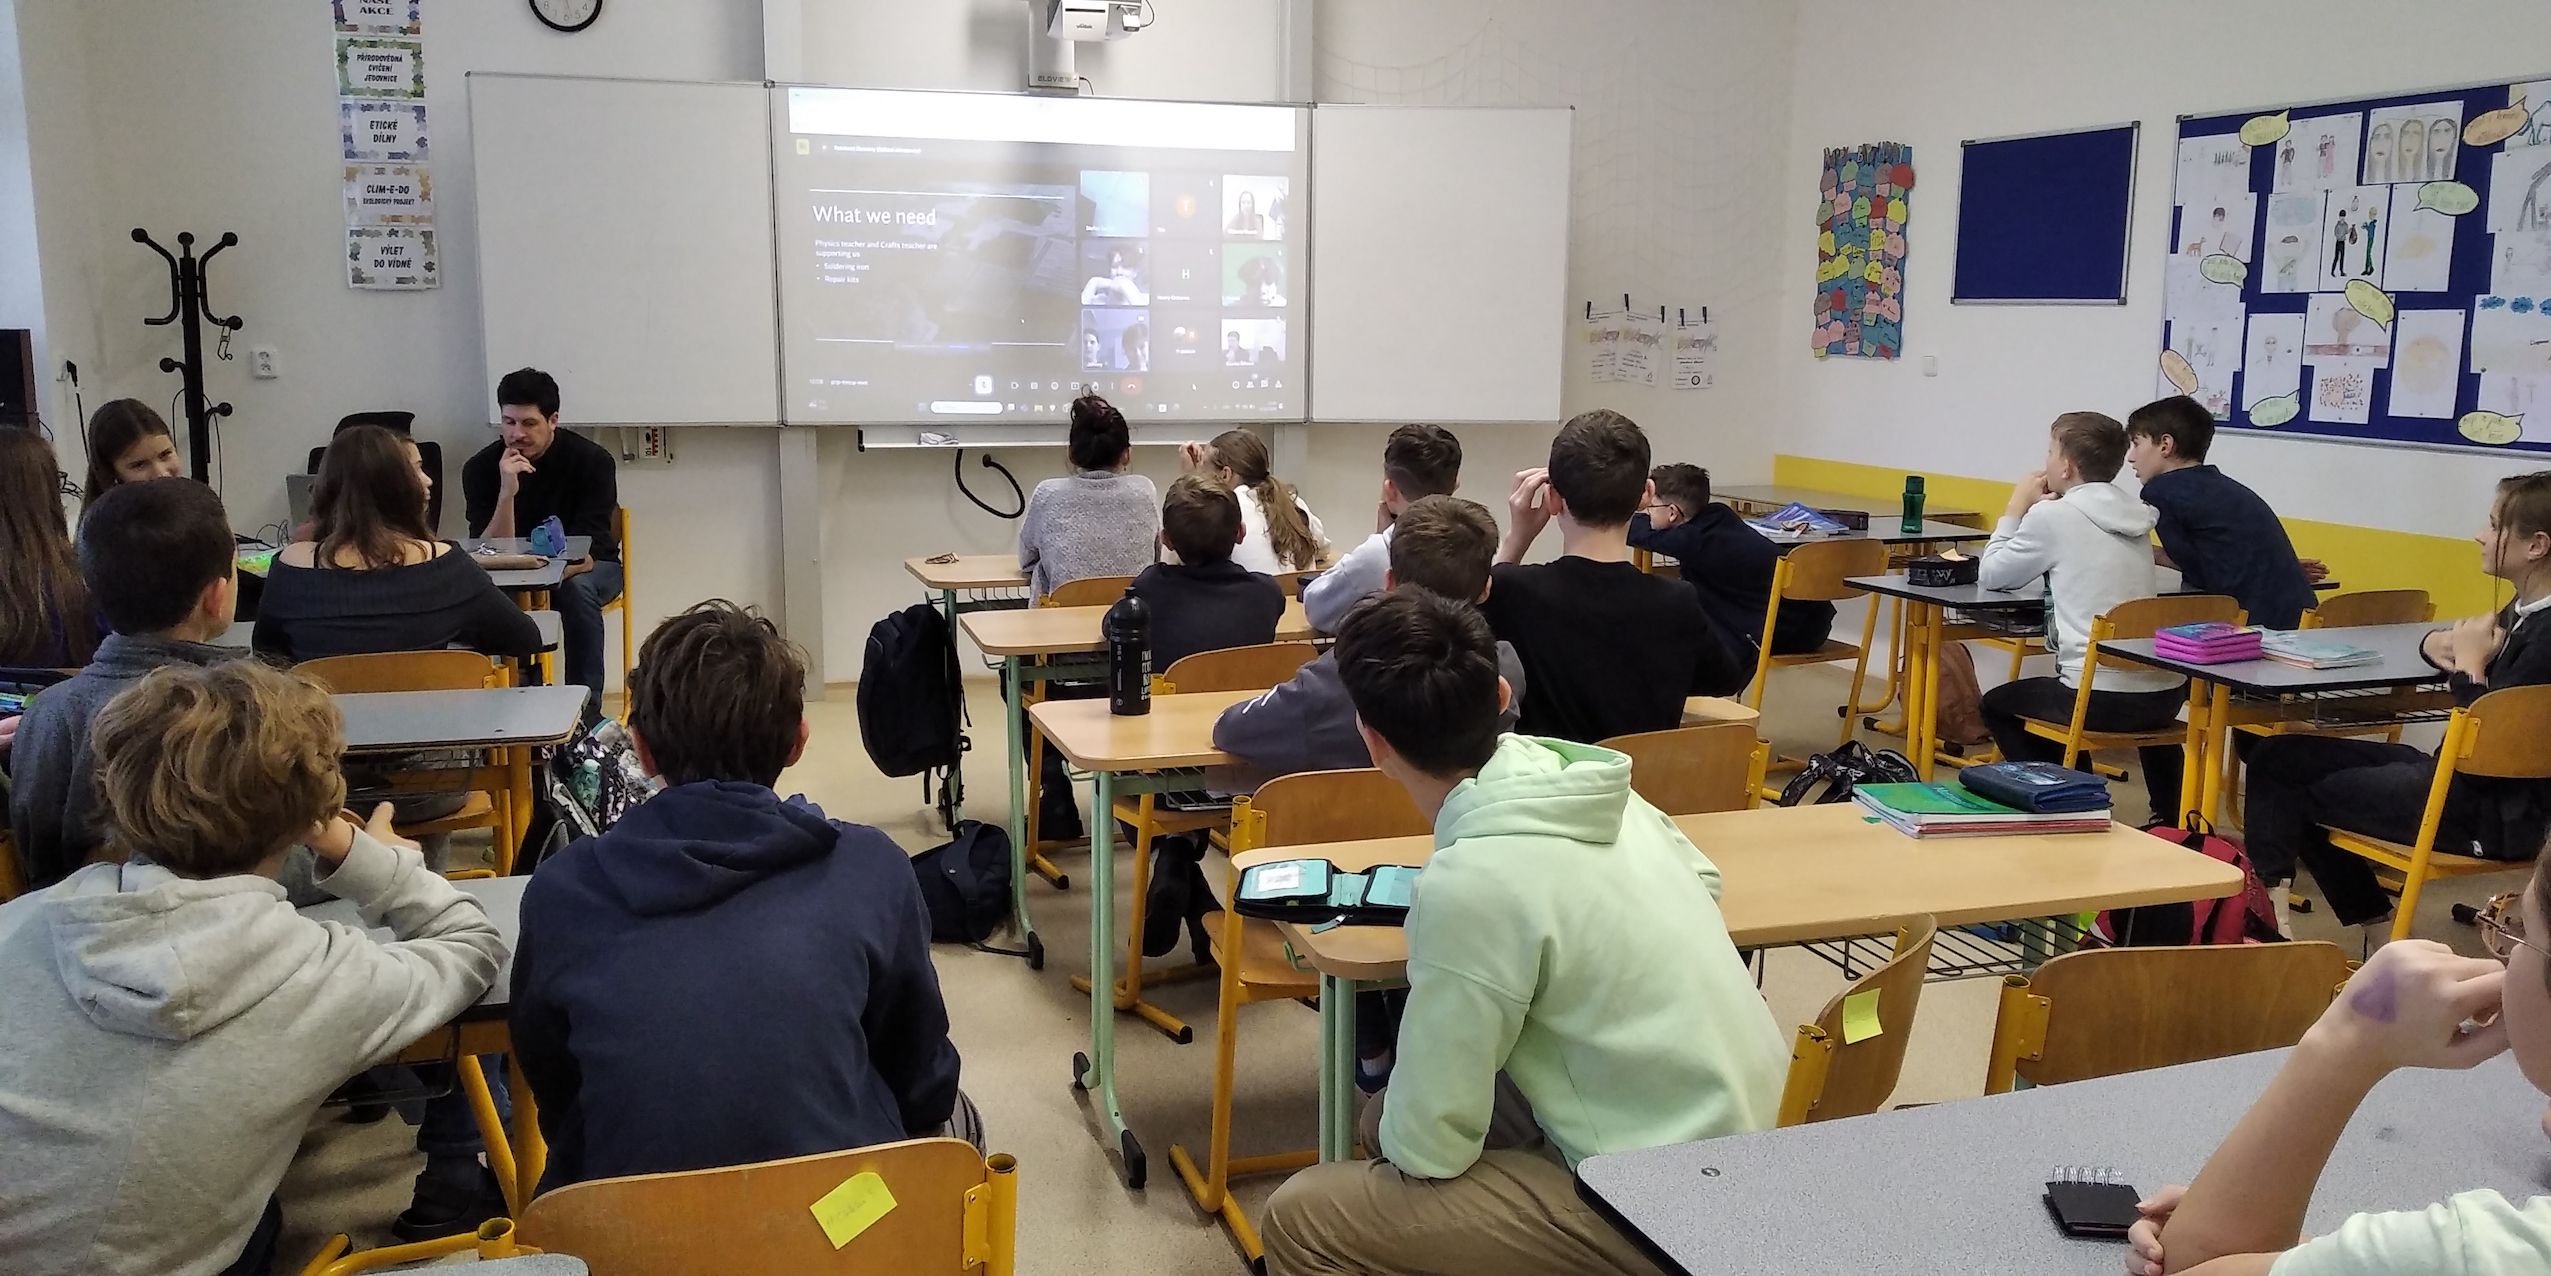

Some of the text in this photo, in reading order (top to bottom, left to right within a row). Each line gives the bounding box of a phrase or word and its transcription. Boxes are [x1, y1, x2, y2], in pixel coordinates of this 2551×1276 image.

[359, 7, 394, 15] AKCE
[369, 119, 398, 130] ETICKÉ
[373, 132, 397, 143] DÍLNY
[366, 185, 410, 194] CLIM-E-DO
[812, 204, 936, 226] What we need
[815, 239, 840, 248] Physics
[841, 240, 866, 248] teacher
[867, 240, 879, 248] and
[880, 241, 900, 249] Crafts
[901, 242, 926, 250] teacher
[380, 244, 404, 255] VÝLET
[815, 250, 851, 259] supporting
[374, 259, 385, 268] DO
[824, 263, 855, 271] Soldering
[824, 275, 846, 284] Repair
